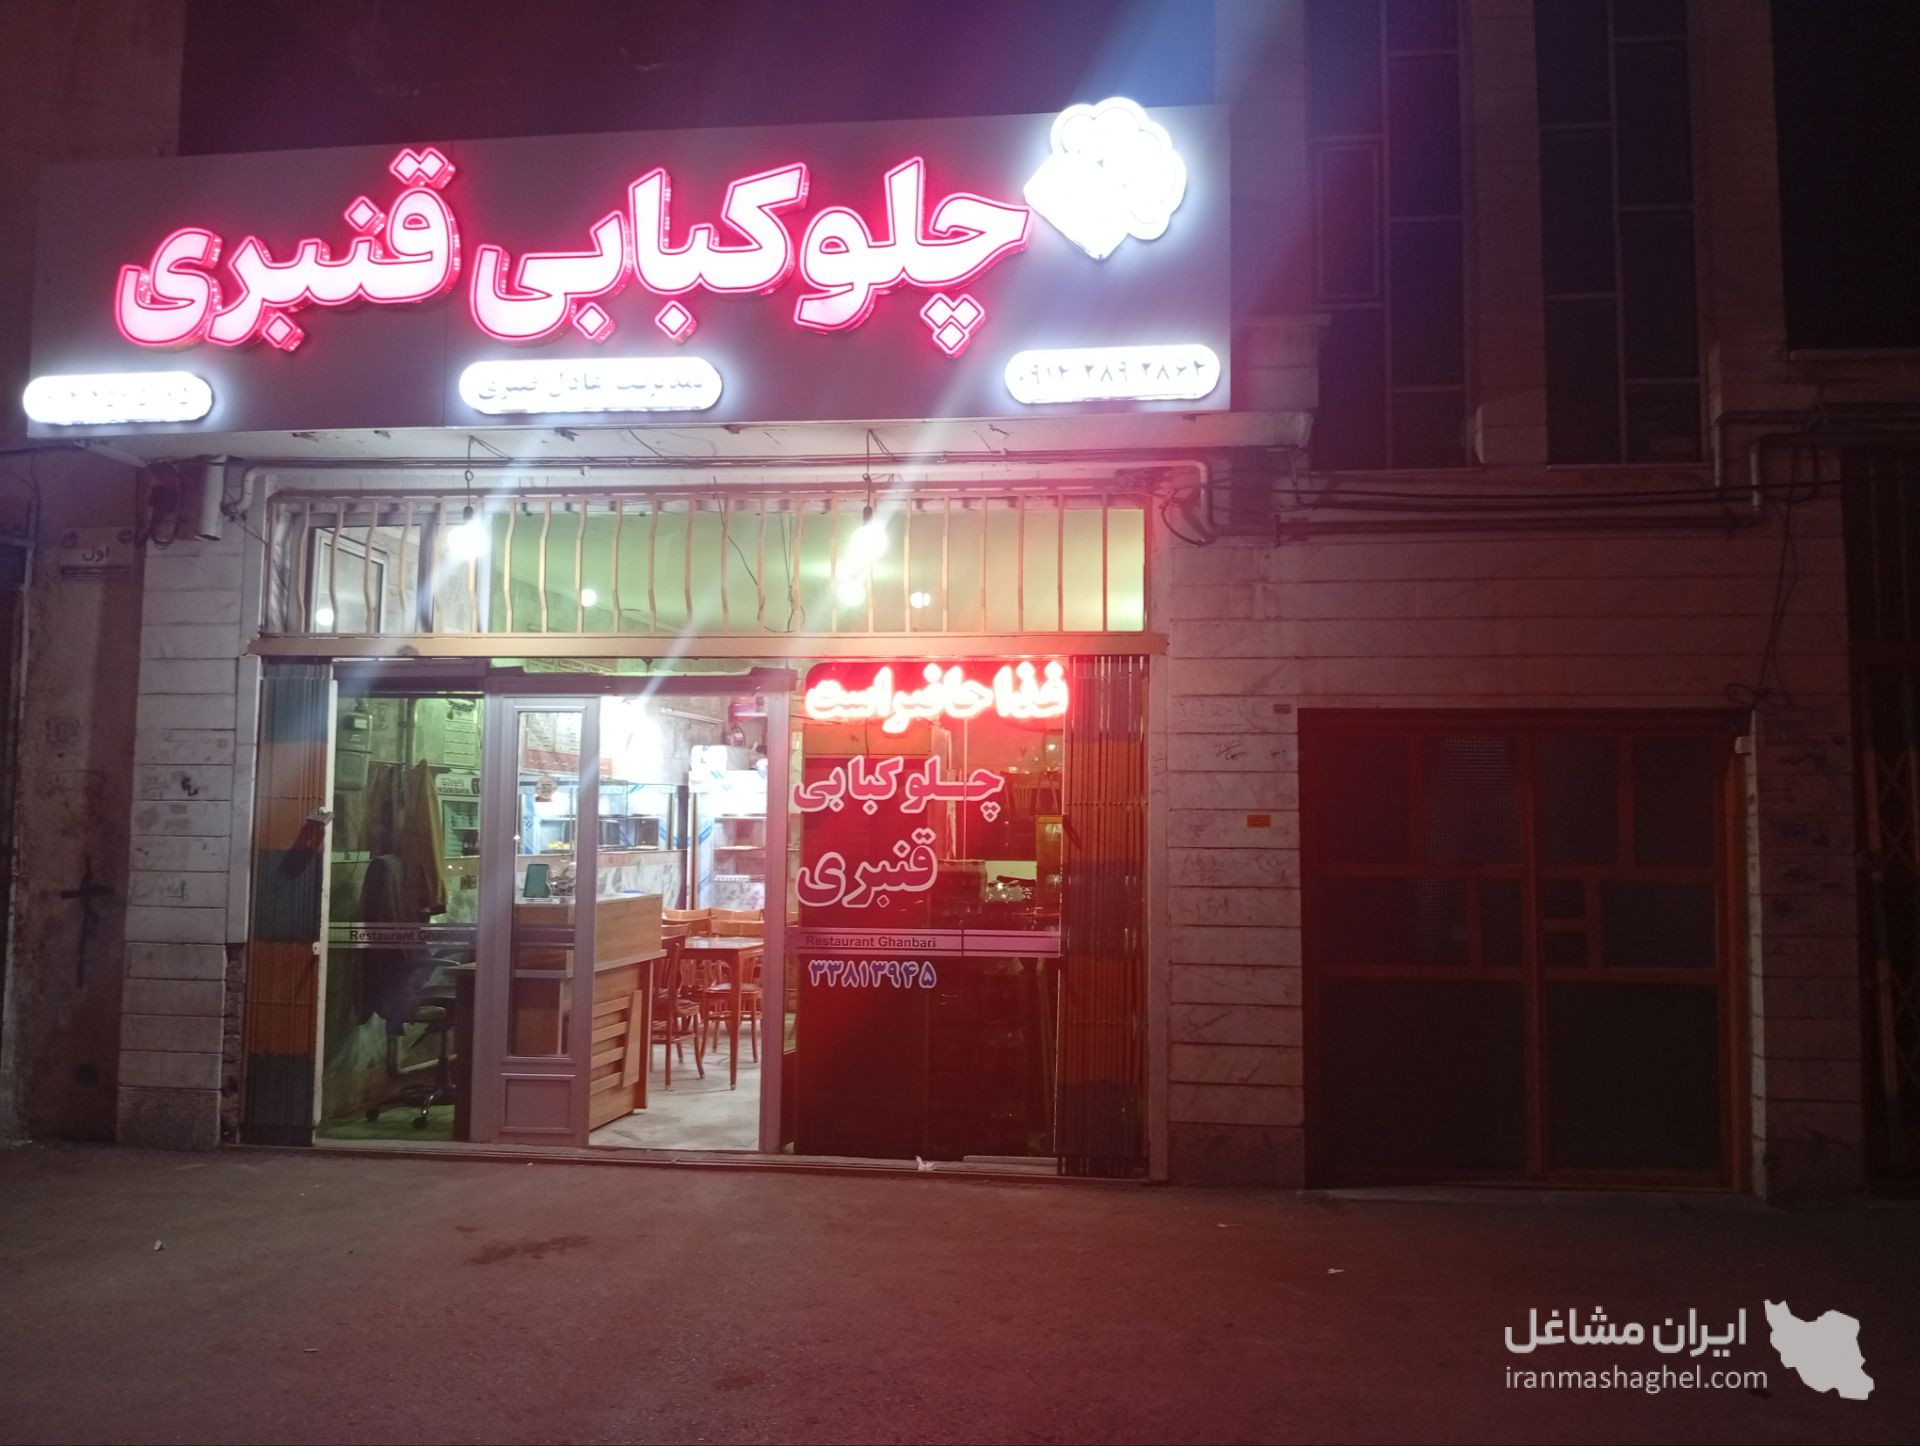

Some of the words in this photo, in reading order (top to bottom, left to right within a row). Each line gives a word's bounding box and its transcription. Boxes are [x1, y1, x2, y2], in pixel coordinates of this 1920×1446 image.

[115, 147, 458, 351] قنبری
[804, 665, 894, 720] است
[881, 662, 995, 734] حاضر
[796, 827, 938, 908] قنبری
[349, 930, 415, 941] Restaurant
[805, 935, 875, 947] Restaurant
[878, 936, 937, 948] Ghanbari
[808, 959, 937, 989] ۳۳۸۱۳۹۴۵
